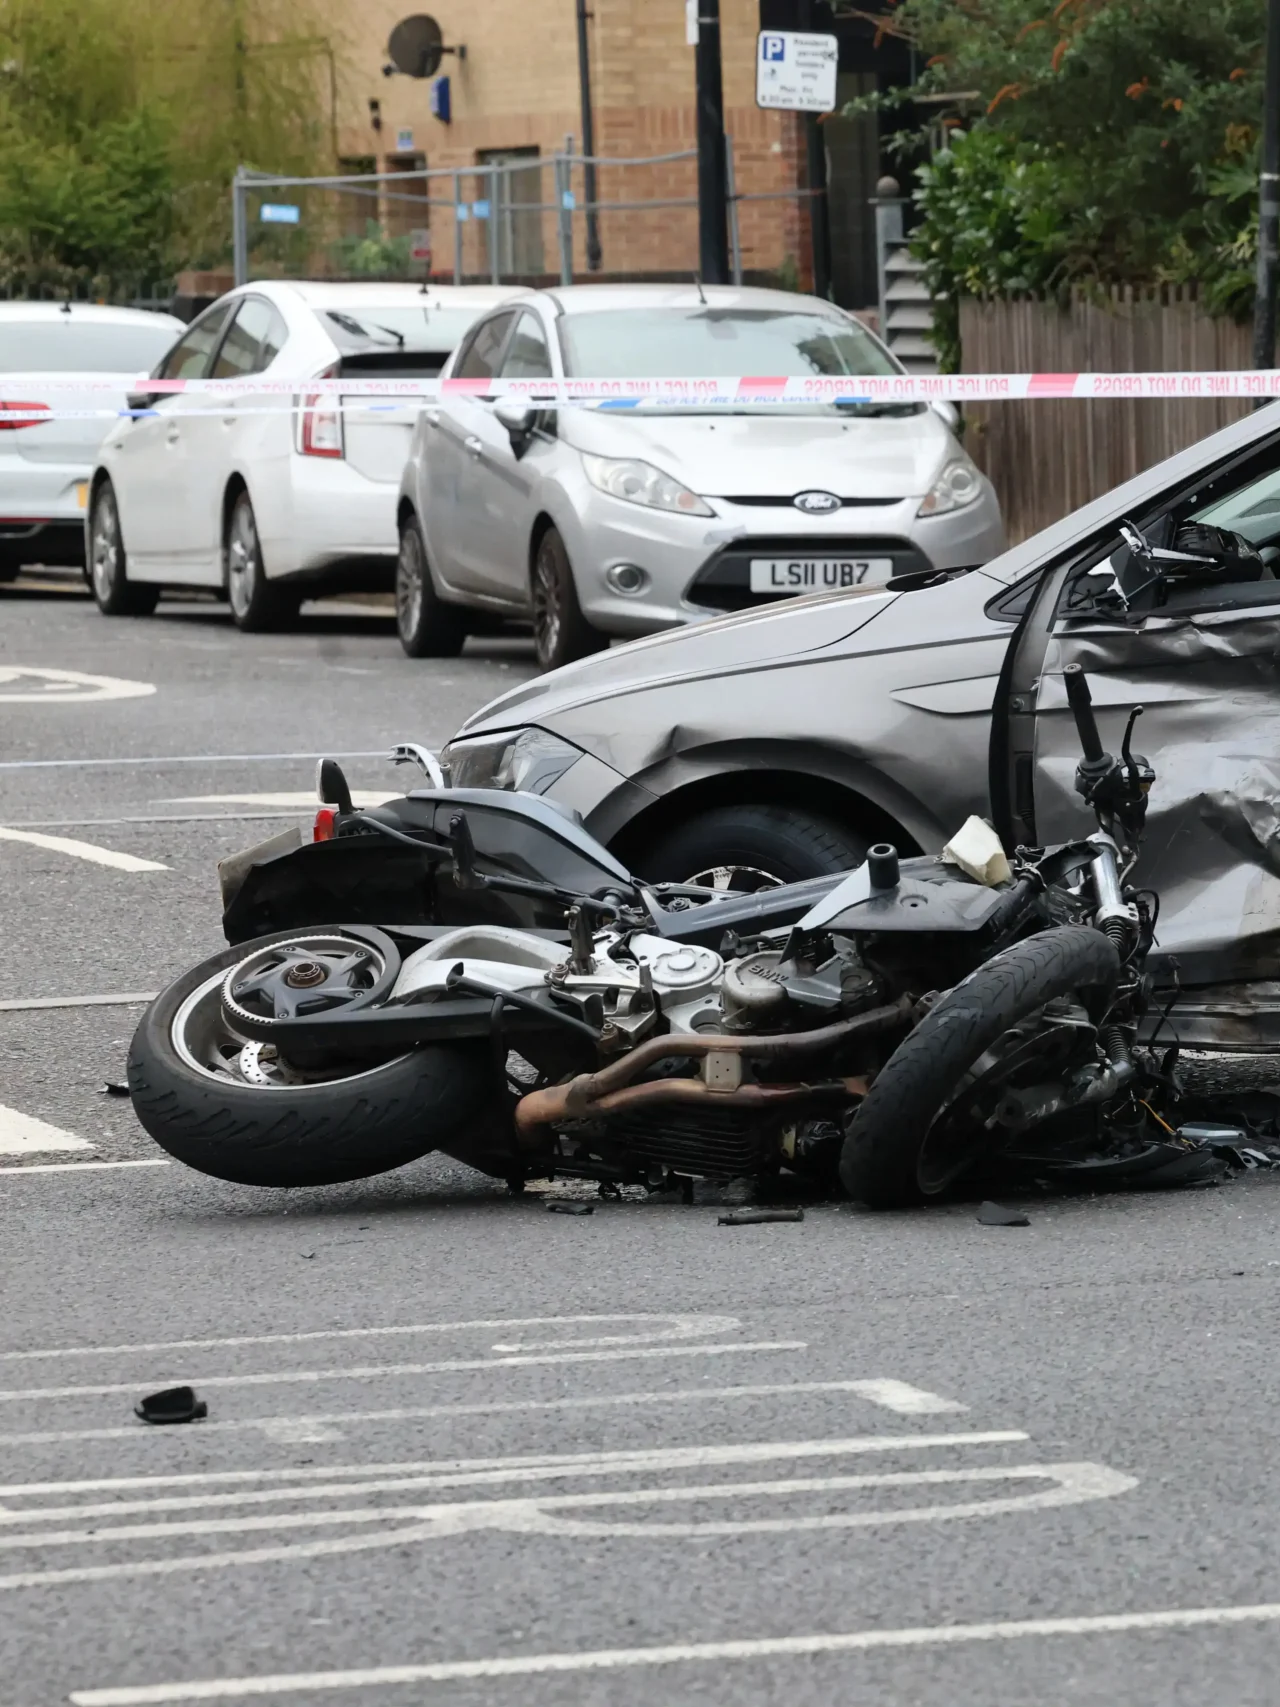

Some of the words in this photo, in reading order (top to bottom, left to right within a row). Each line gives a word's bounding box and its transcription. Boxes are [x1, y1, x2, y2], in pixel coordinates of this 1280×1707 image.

[767, 39, 782, 60] P
[823, 563, 869, 586] UB7
[748, 964, 789, 982] BMW
